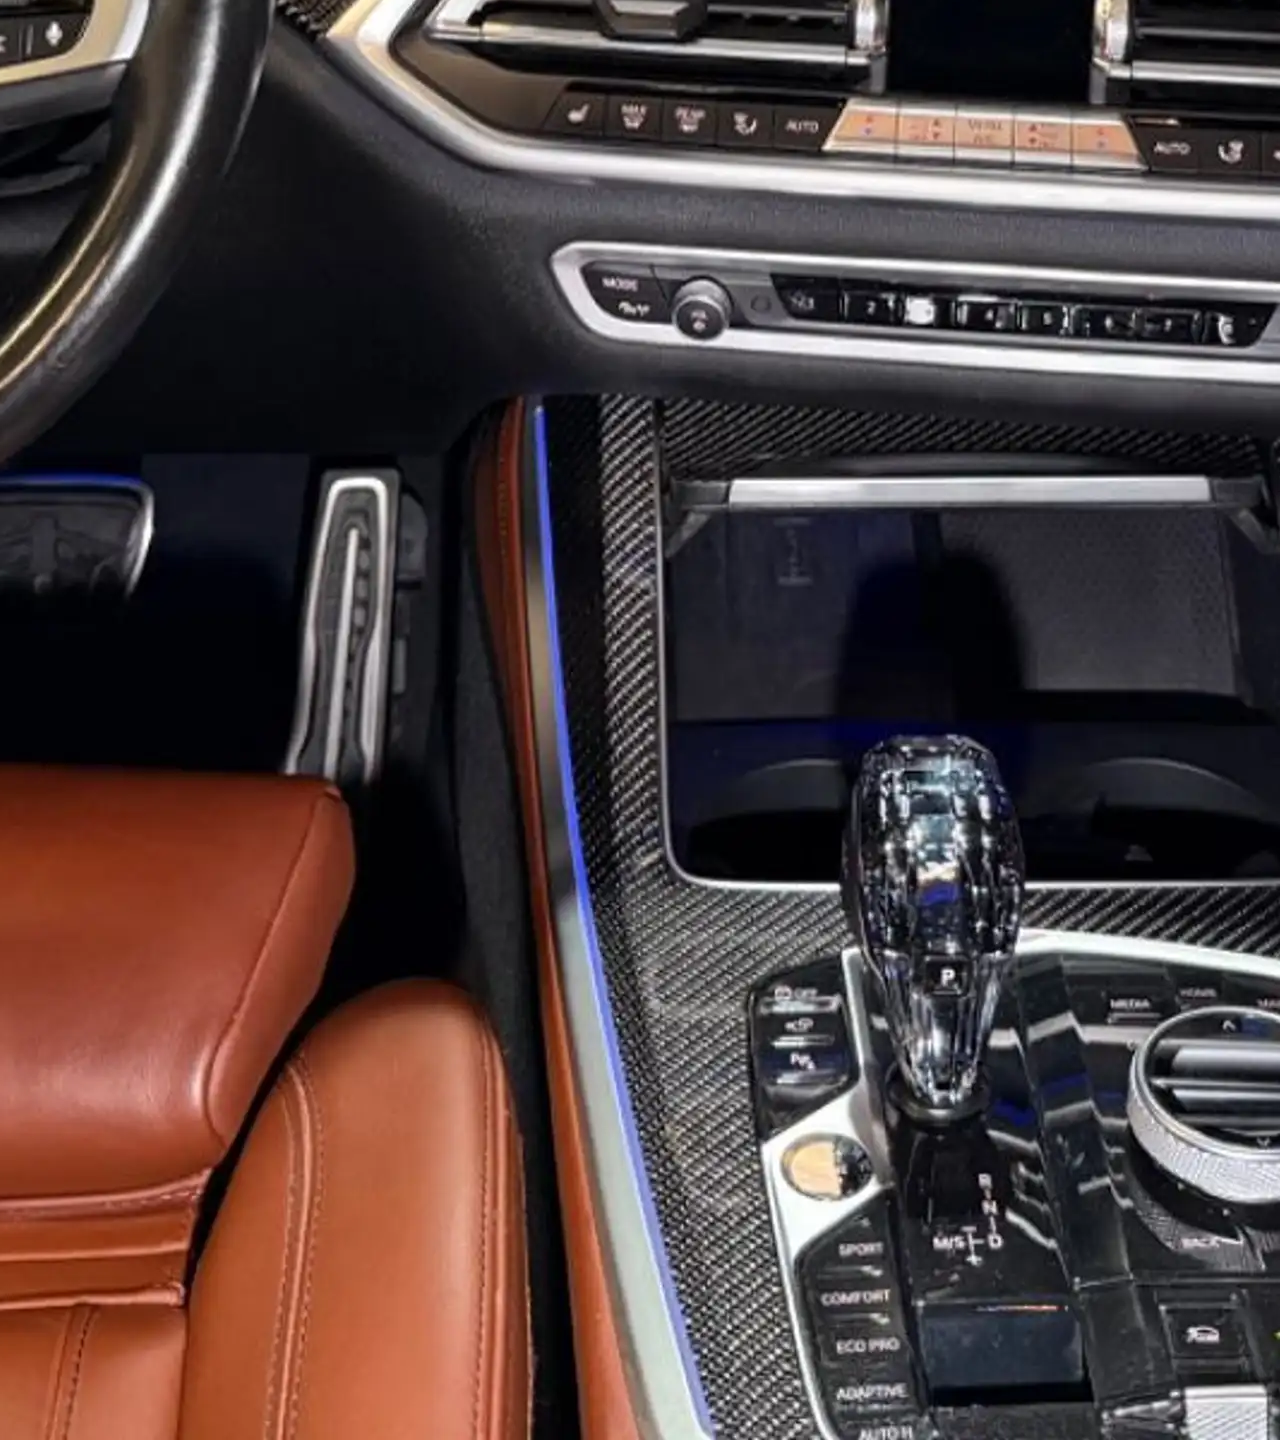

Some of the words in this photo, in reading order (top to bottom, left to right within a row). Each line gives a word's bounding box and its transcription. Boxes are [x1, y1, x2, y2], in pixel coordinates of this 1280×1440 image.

[784, 119, 819, 135] AUTO
[1153, 140, 1191, 156] AUTO
[940, 968, 956, 986] P
[838, 1241, 884, 1257] SPORT
[987, 1233, 1004, 1251] D
[821, 1289, 891, 1307] COMFORT
[836, 1338, 866, 1355] ECO
[868, 1336, 901, 1352] PRO
[836, 1382, 909, 1401] ADAPTIVE
